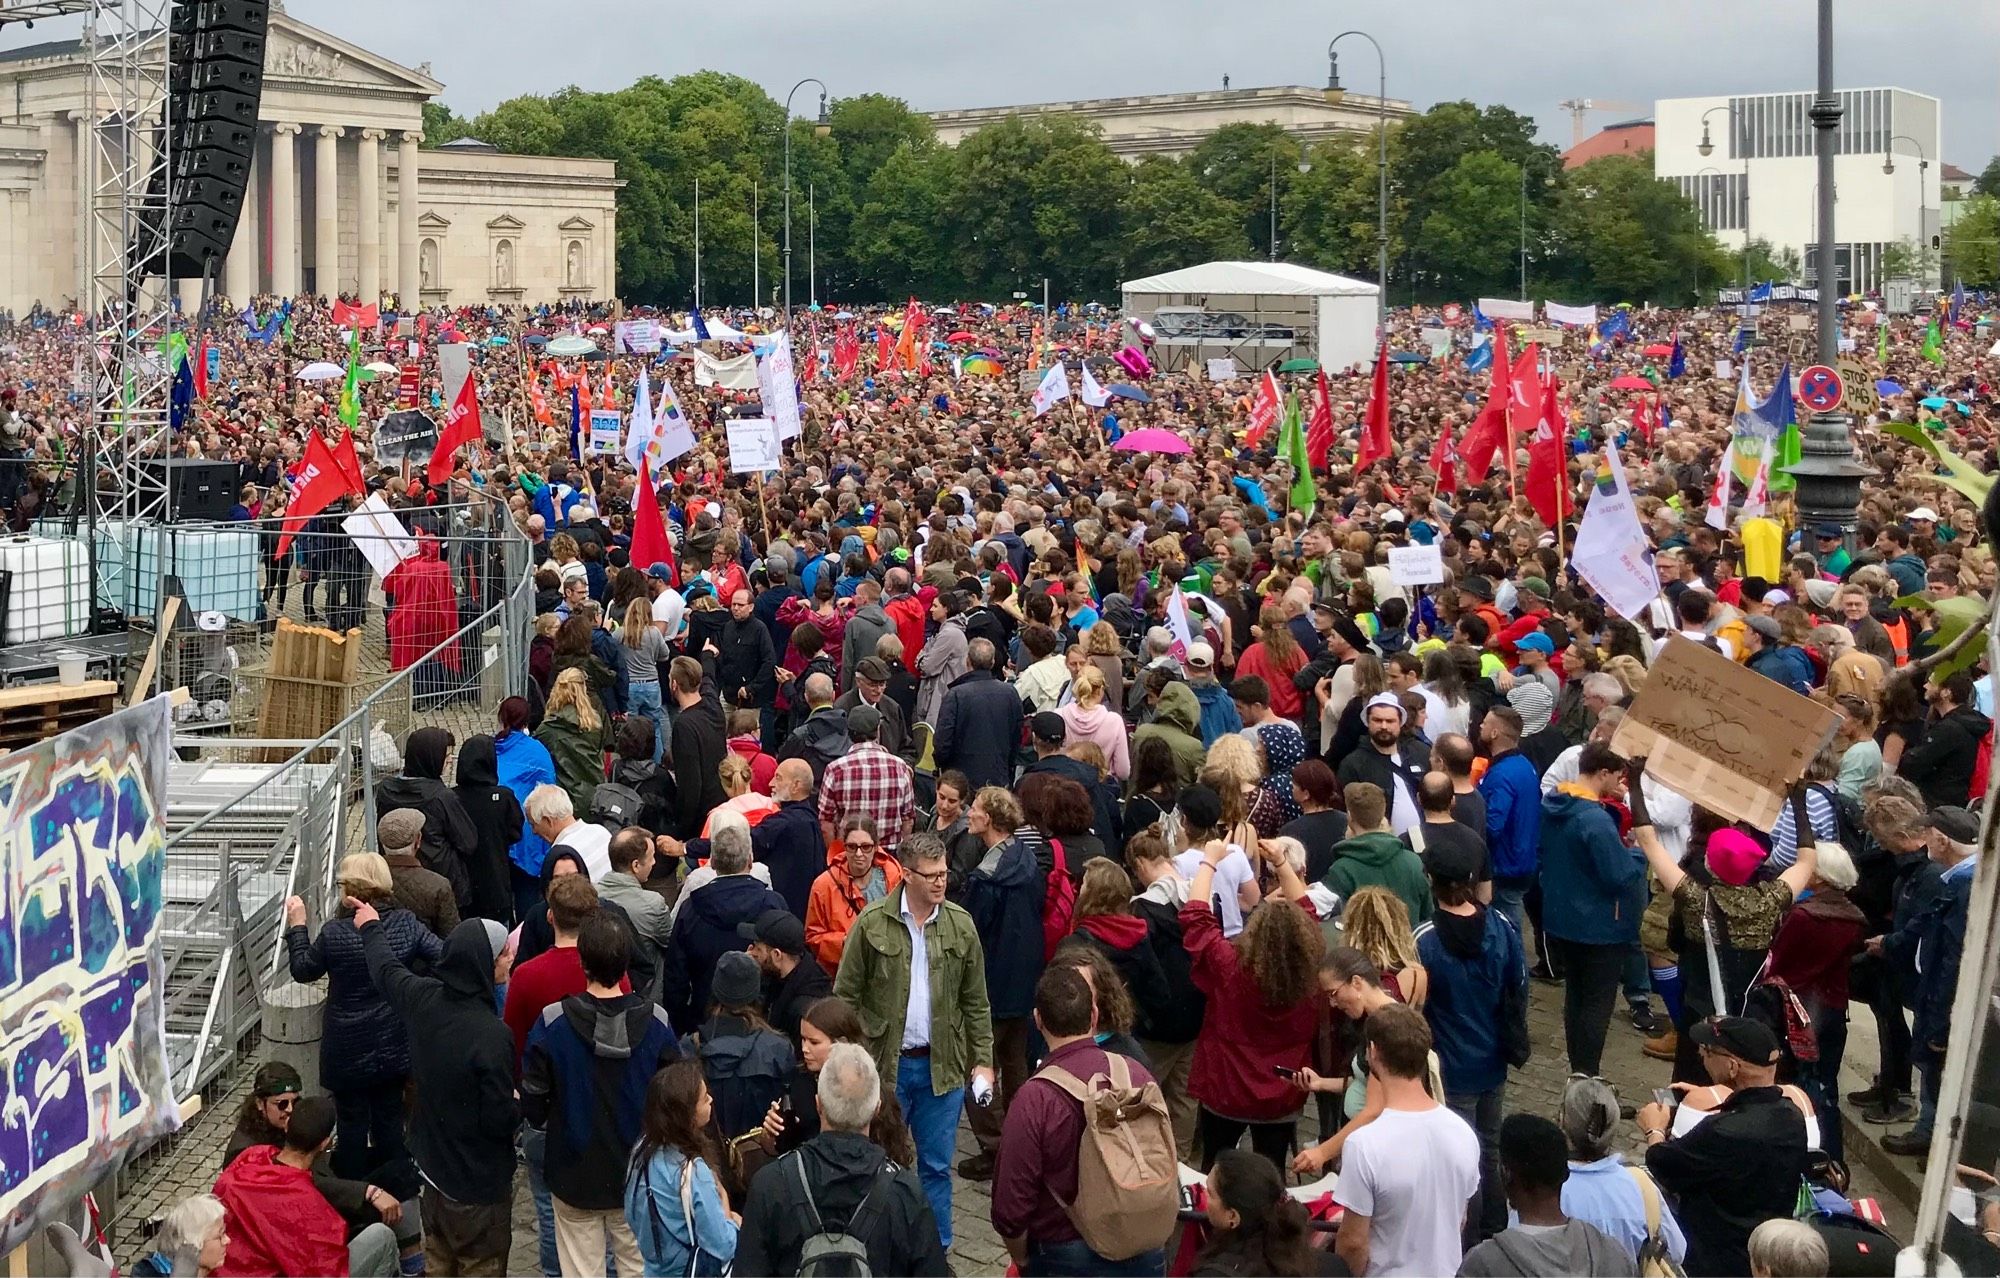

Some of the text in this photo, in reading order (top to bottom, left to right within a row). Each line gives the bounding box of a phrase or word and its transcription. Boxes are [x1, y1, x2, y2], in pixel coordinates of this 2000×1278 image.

[1718, 290, 1744, 303] NEIN
[1771, 286, 1797, 300] NEIN
[1842, 368, 1868, 387] STOP
[1847, 385, 1870, 405] PAG
[378, 429, 434, 447] CLEAN THE AIR
[293, 462, 321, 490] DIE
